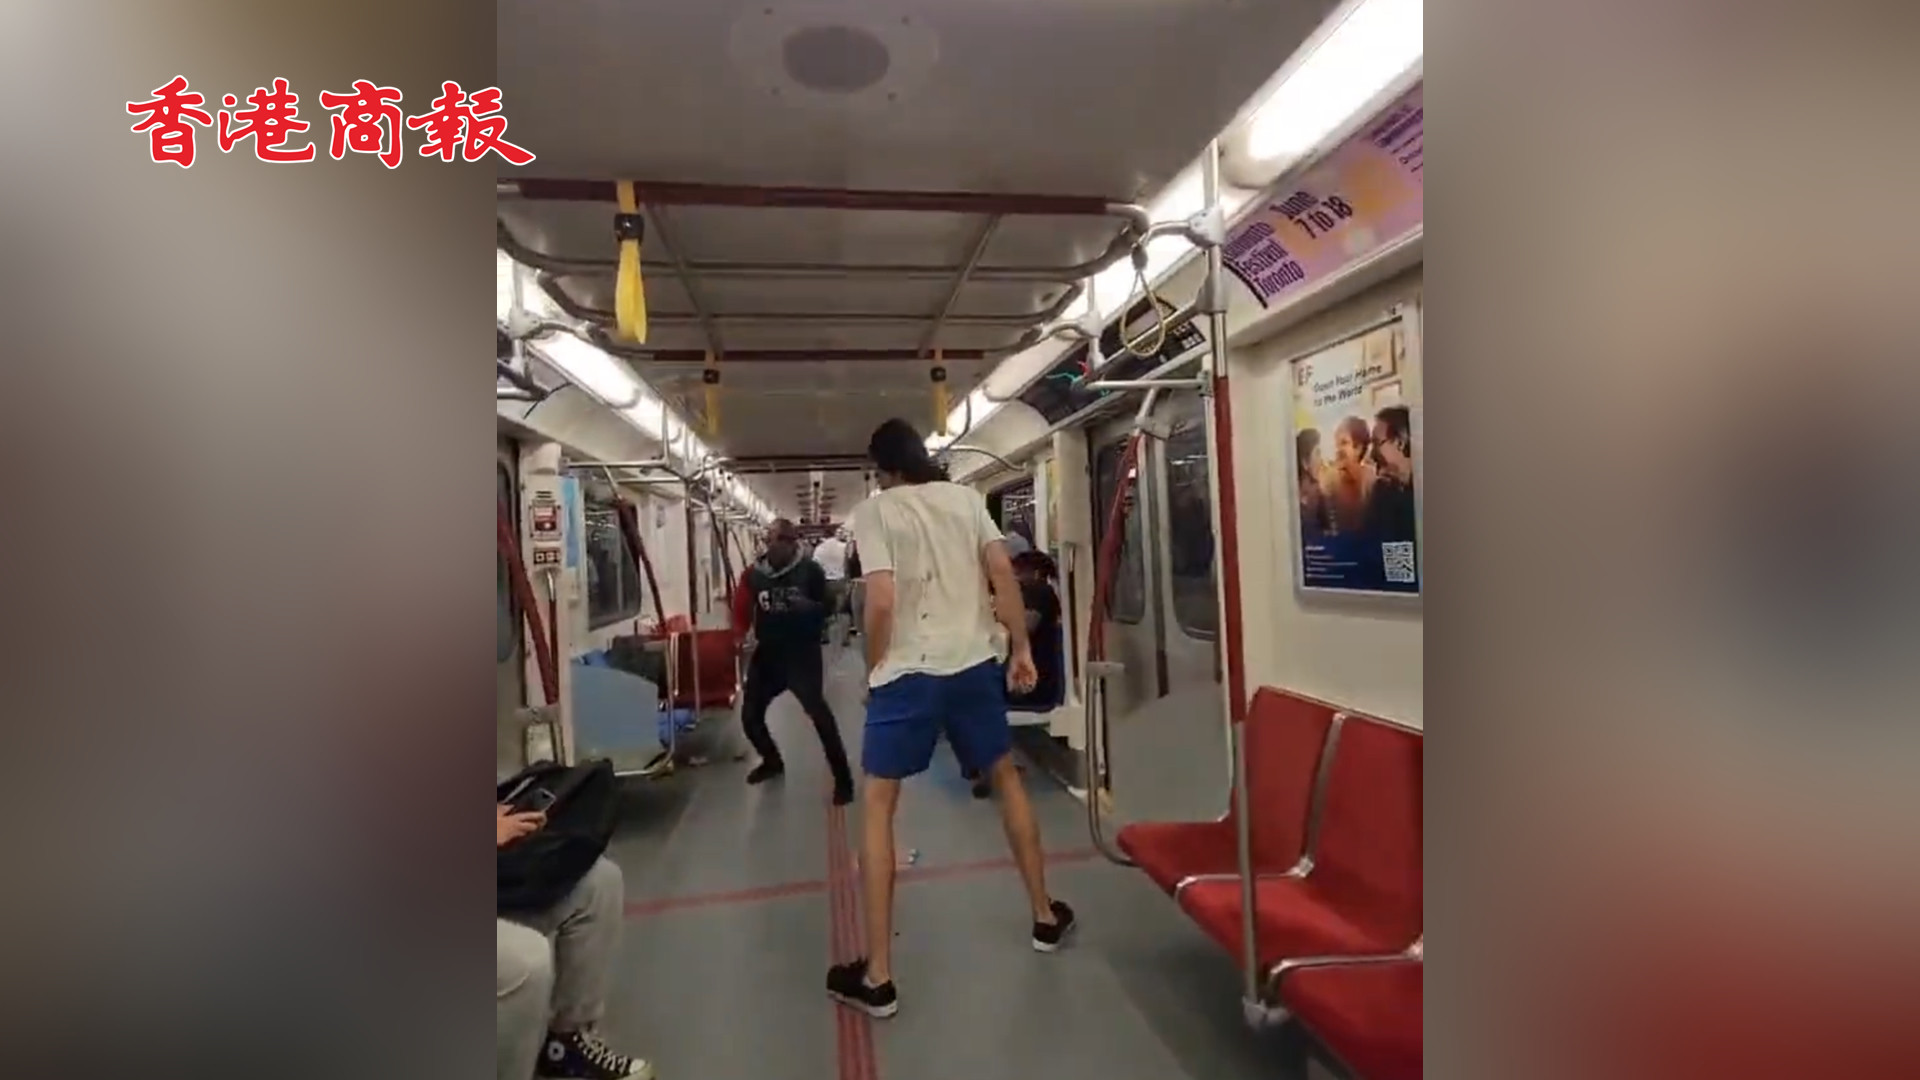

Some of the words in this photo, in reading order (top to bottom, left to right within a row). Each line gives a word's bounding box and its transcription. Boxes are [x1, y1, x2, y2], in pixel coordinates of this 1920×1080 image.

[1293, 218, 1316, 239] 7
[1308, 210, 1335, 233] to
[1322, 196, 1353, 219] 18
[1235, 239, 1289, 279] Festival
[1253, 261, 1304, 298] Toronto
